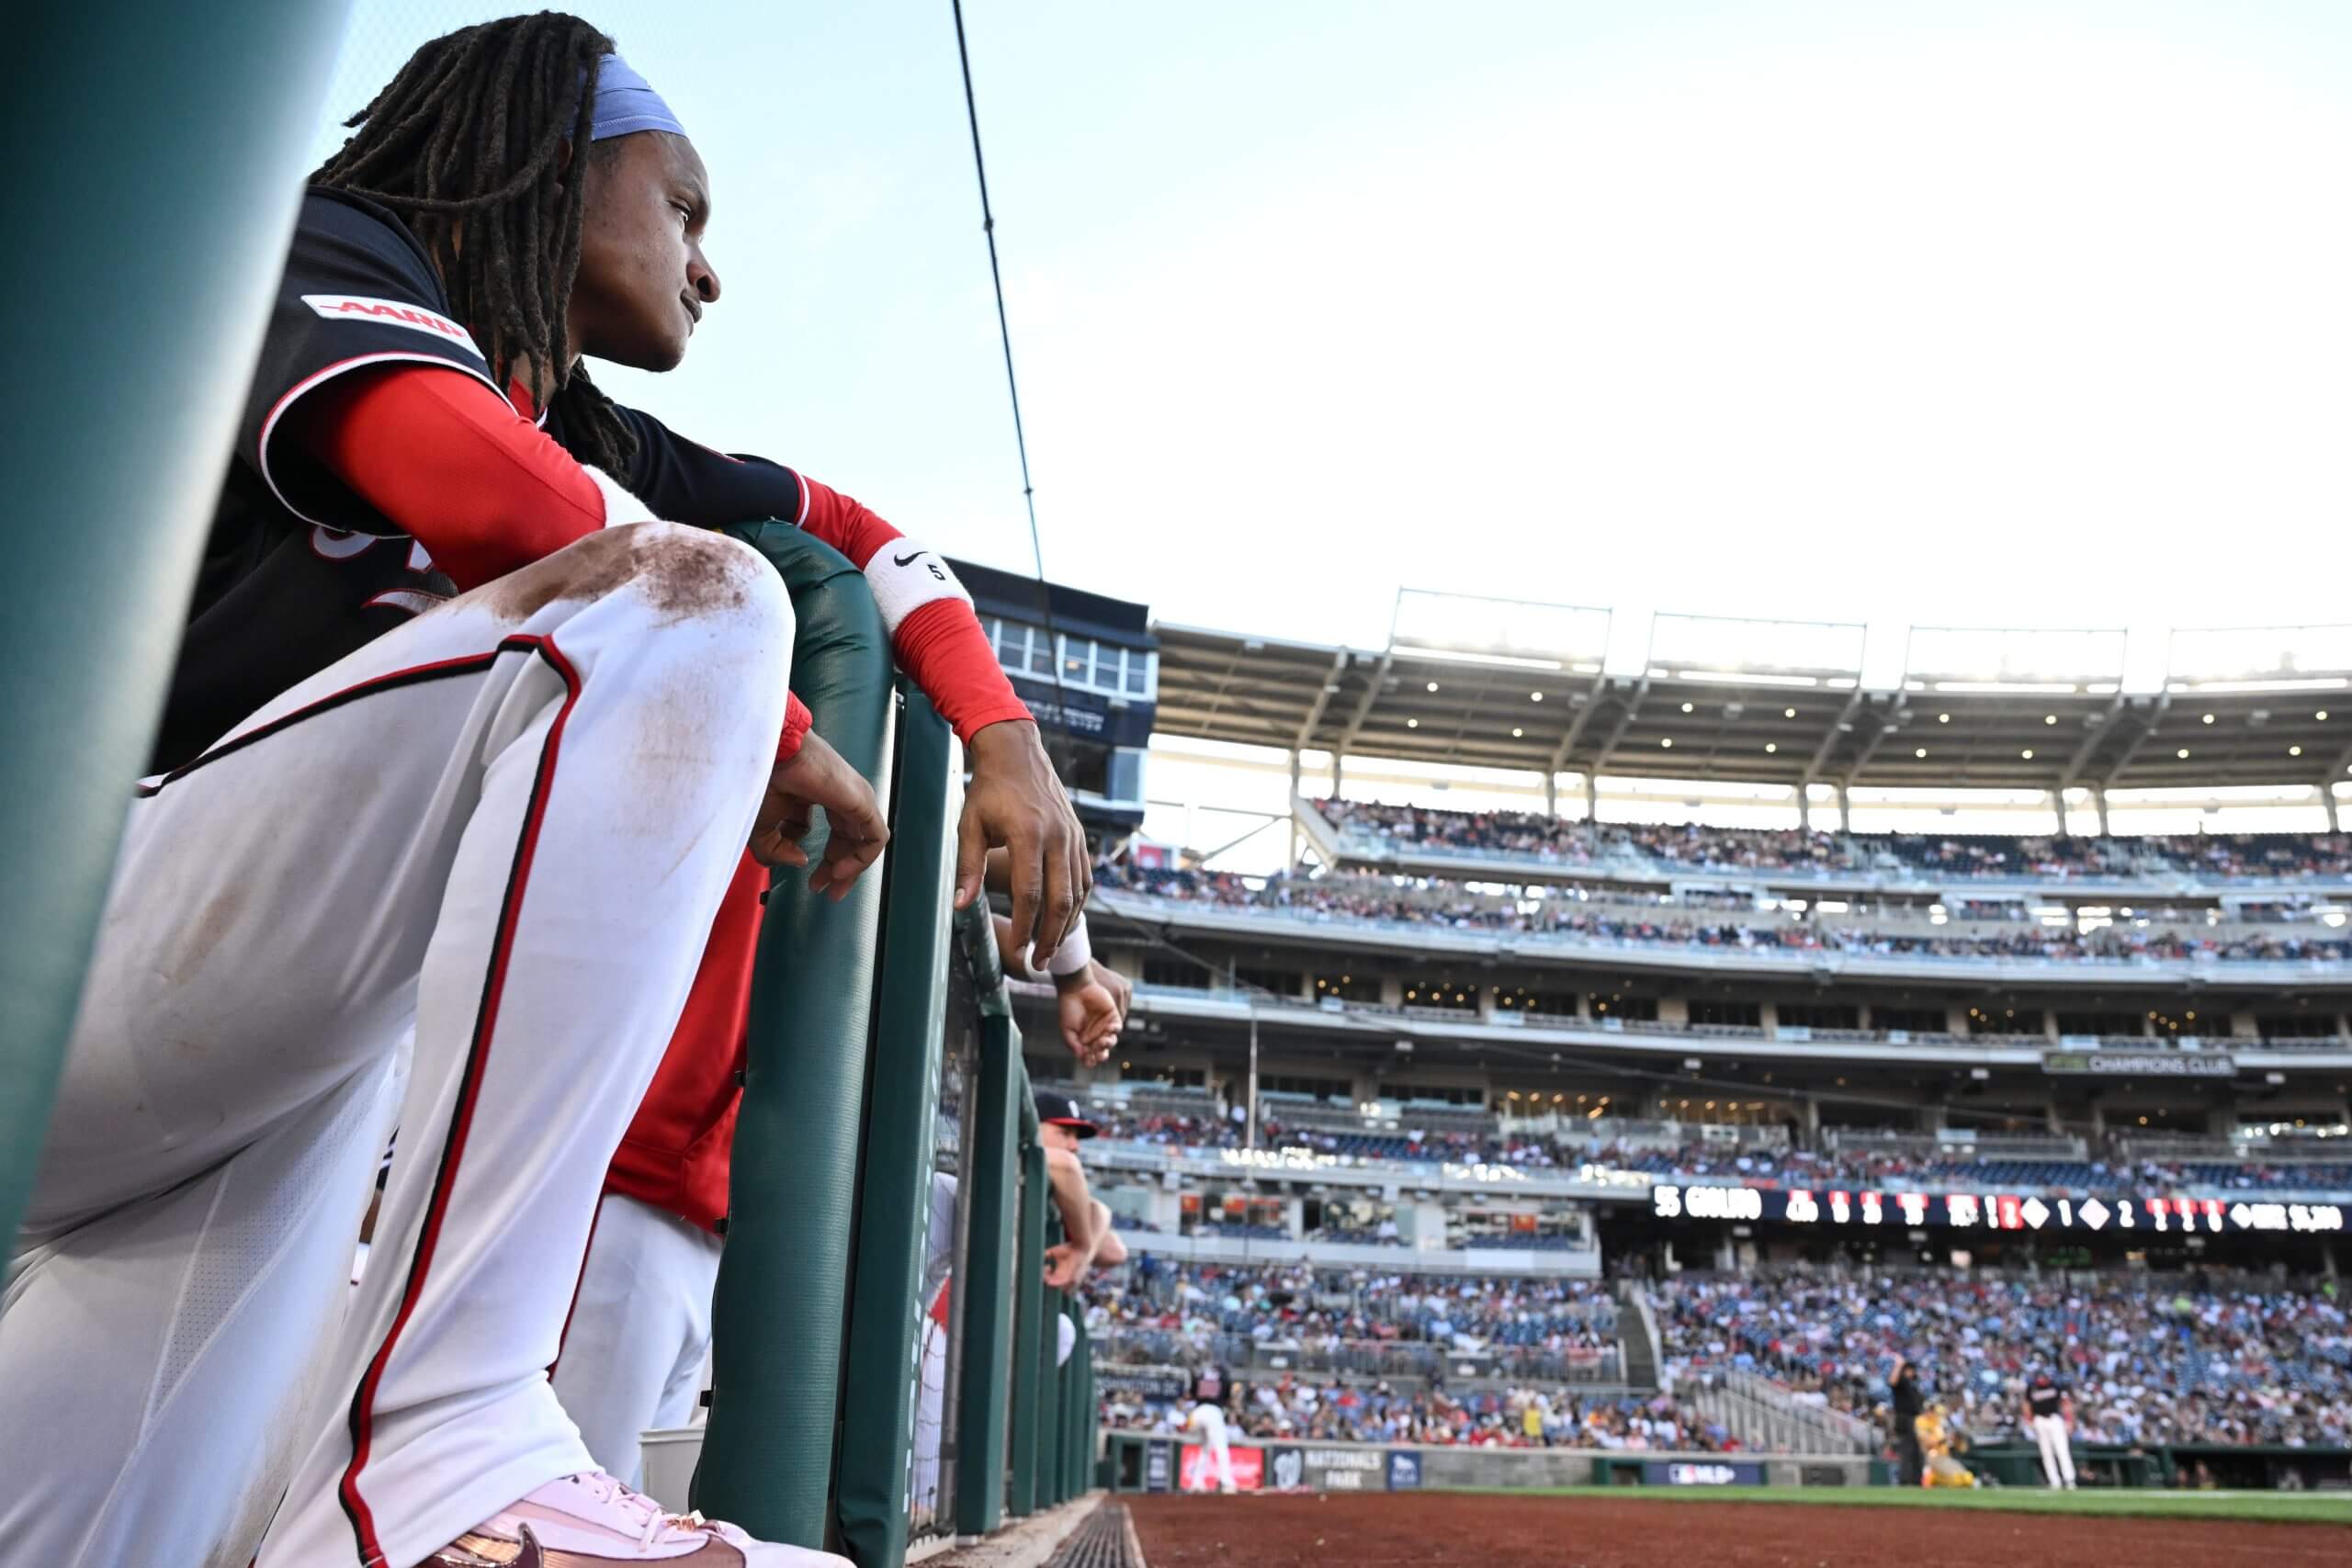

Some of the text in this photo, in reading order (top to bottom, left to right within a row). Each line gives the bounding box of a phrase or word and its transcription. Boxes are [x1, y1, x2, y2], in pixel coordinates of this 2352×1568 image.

[333, 301, 467, 338] AARP
[927, 564, 946, 581] 5
[2088, 1055, 2186, 1073] CHAMPIONS
[2188, 1056, 2230, 1074] CLUB
[1305, 1450, 1382, 1470] NATIONALS
[1325, 1470, 1363, 1488] PARK
